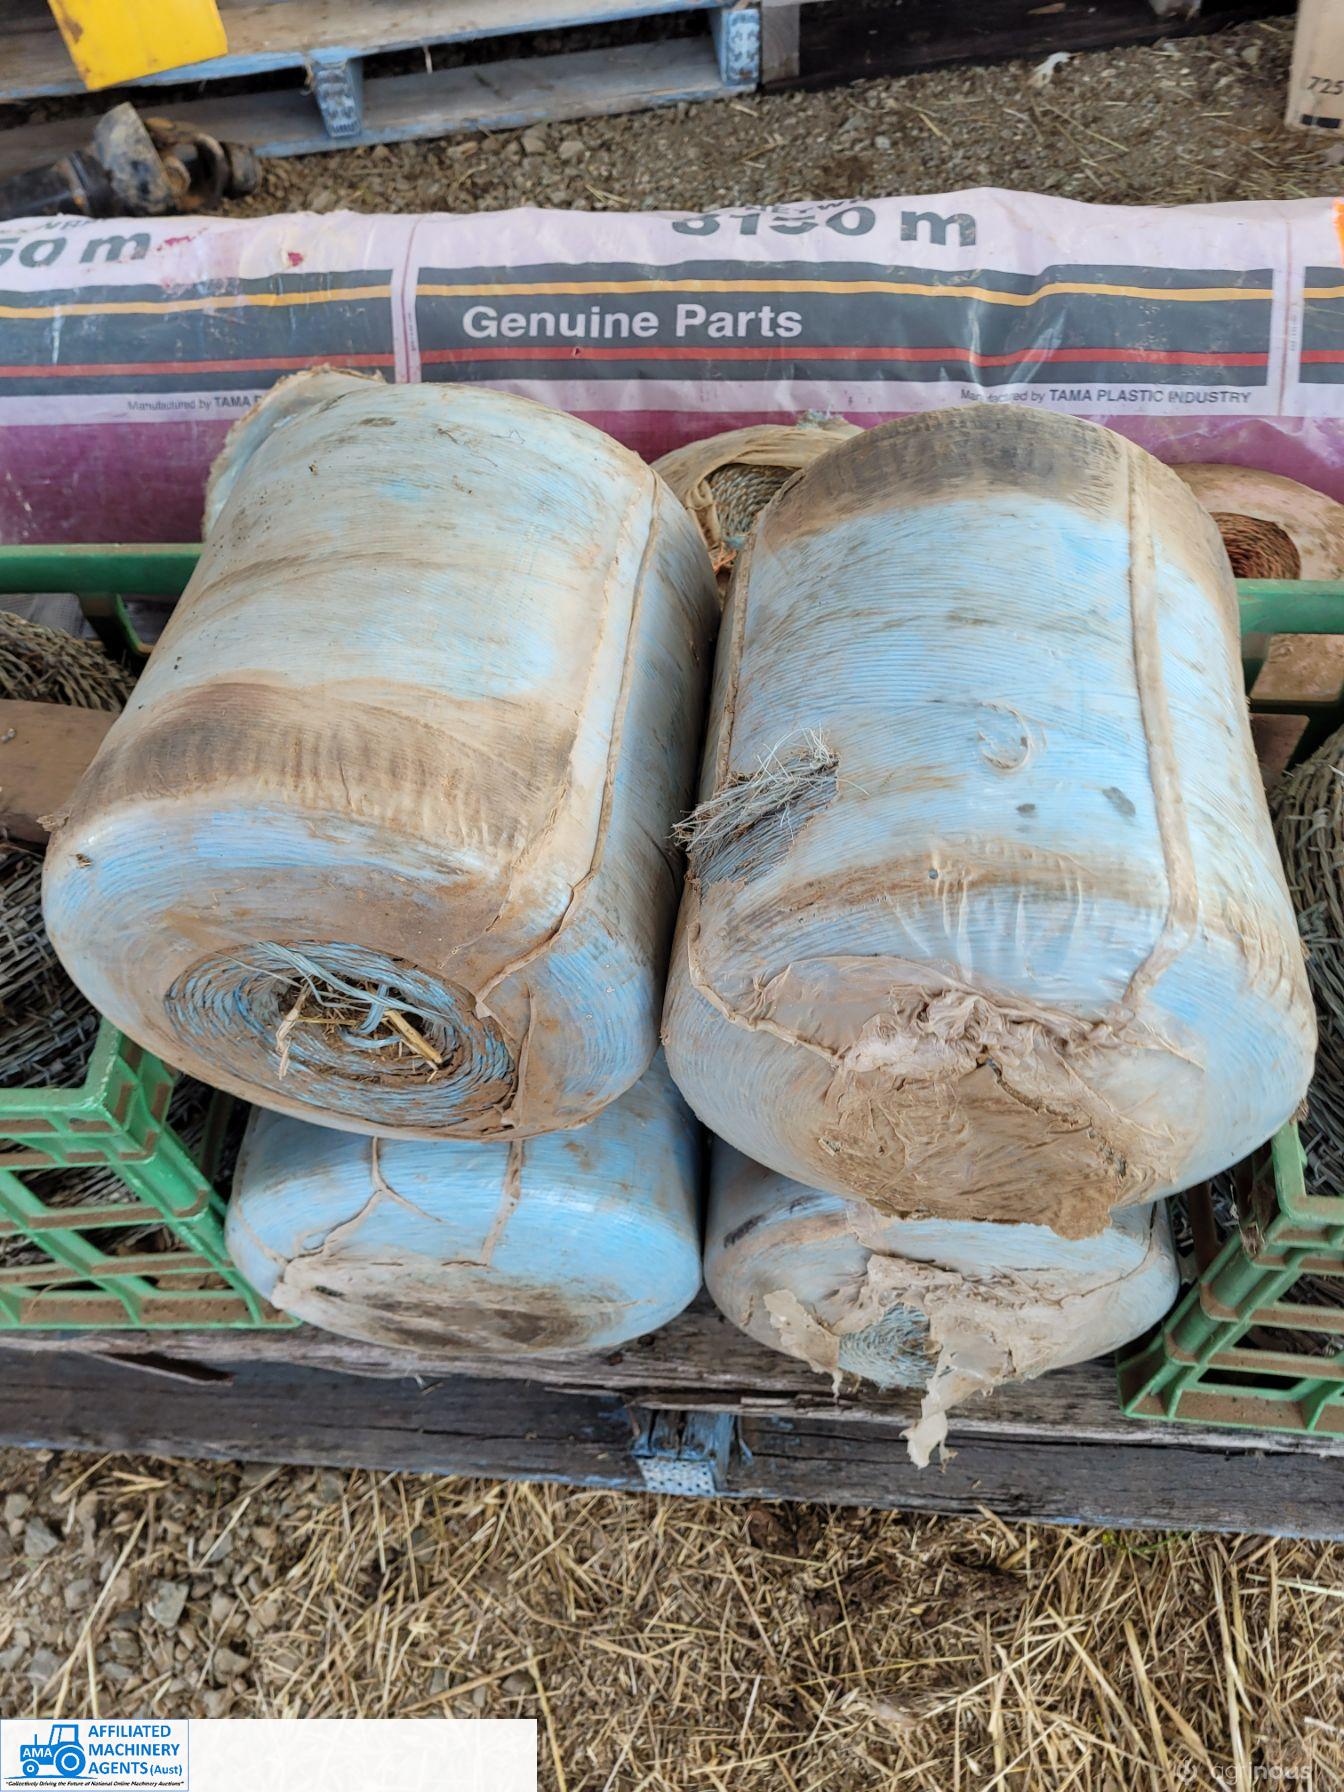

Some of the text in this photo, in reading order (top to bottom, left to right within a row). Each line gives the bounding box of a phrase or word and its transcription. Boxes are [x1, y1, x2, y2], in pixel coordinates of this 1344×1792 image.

[900, 210, 977, 247] m
[79, 232, 152, 264] m
[463, 303, 803, 339] Genuine Parts
[127, 400, 196, 411] Manufactured
[199, 399, 211, 409] by
[214, 395, 250, 408] TAMA
[1031, 391, 1046, 403] by
[1049, 389, 1092, 401] TAMA
[1097, 389, 1164, 402] PLASTIC
[1168, 391, 1251, 404] INDUSTRY
